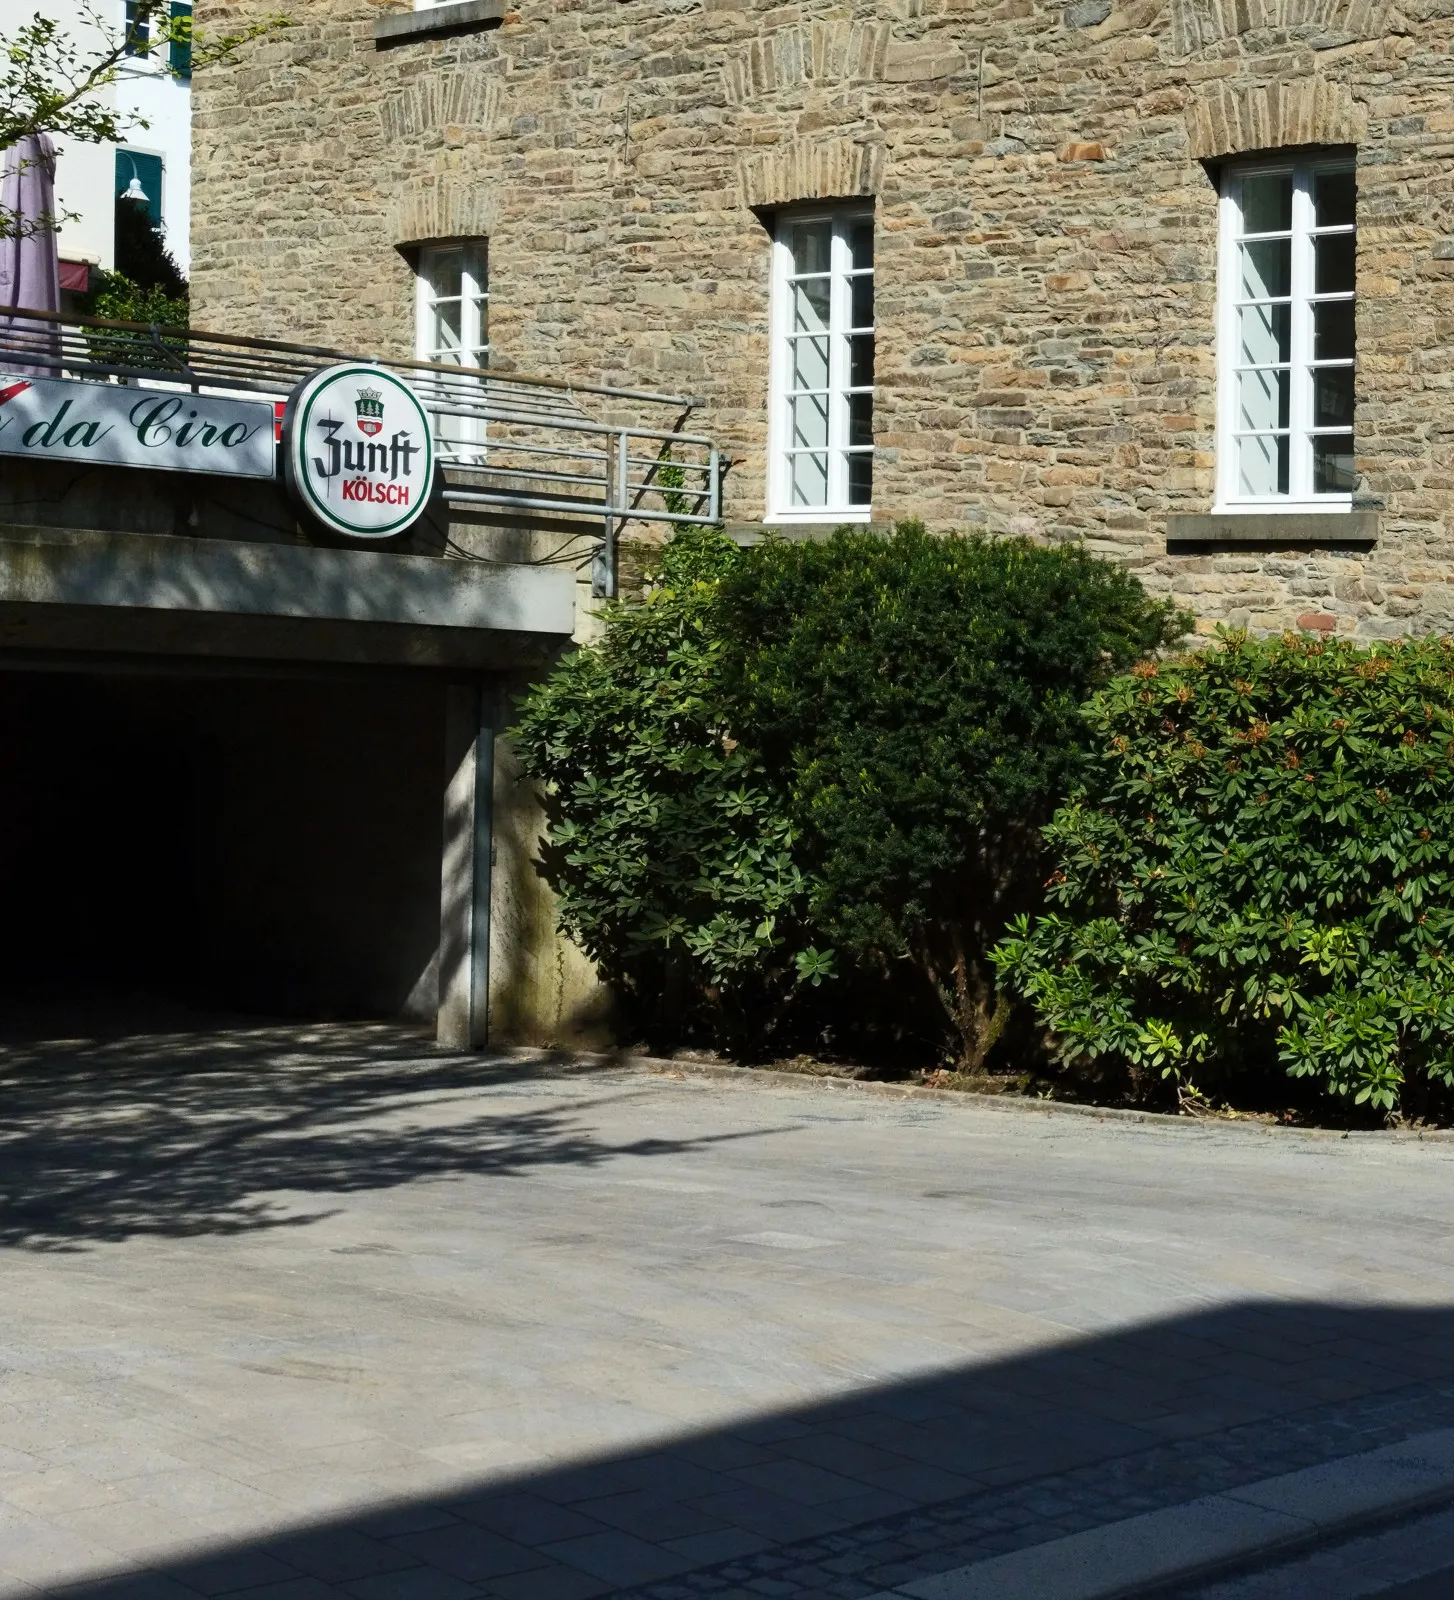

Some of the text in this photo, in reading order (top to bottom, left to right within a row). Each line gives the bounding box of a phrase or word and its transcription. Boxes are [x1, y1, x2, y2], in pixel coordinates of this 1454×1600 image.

[22, 397, 261, 448] da Ciro
[311, 417, 422, 483] Zunft
[342, 475, 409, 506] KÖLSCH
